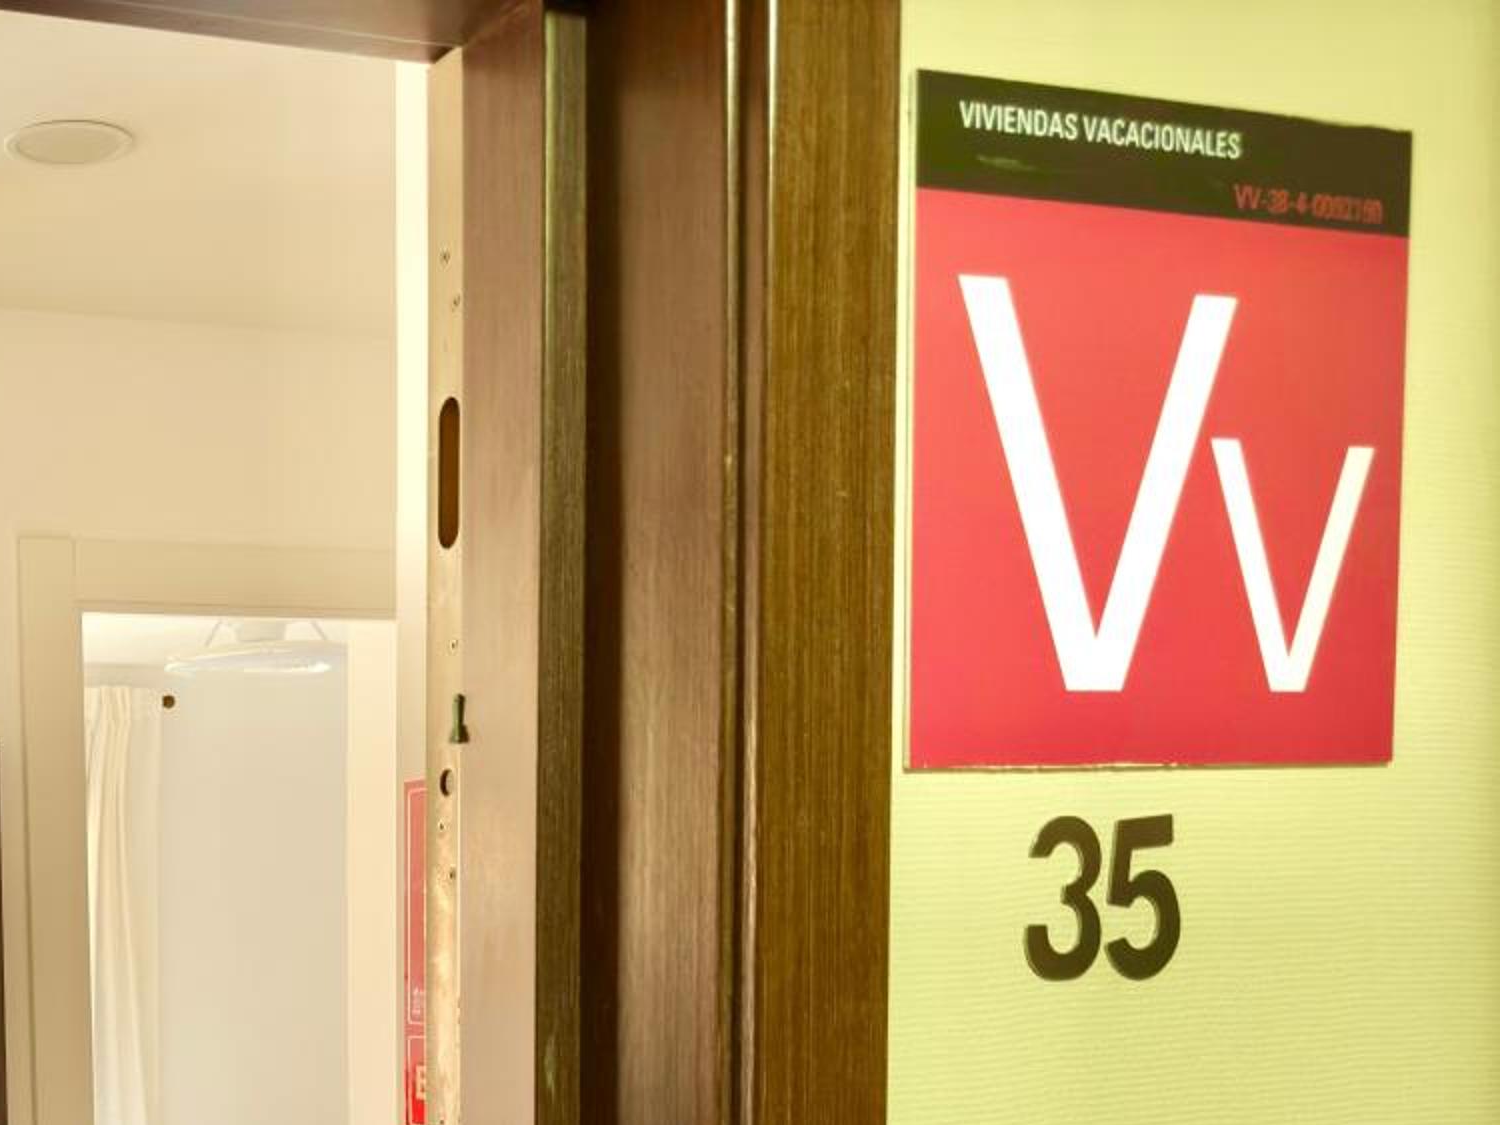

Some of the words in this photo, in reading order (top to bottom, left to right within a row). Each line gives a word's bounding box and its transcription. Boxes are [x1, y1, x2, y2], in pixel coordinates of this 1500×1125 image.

[958, 100, 1079, 142] VIVIENDAS
[1082, 115, 1243, 160] VACACIONALES
[1023, 813, 1182, 982] 35
